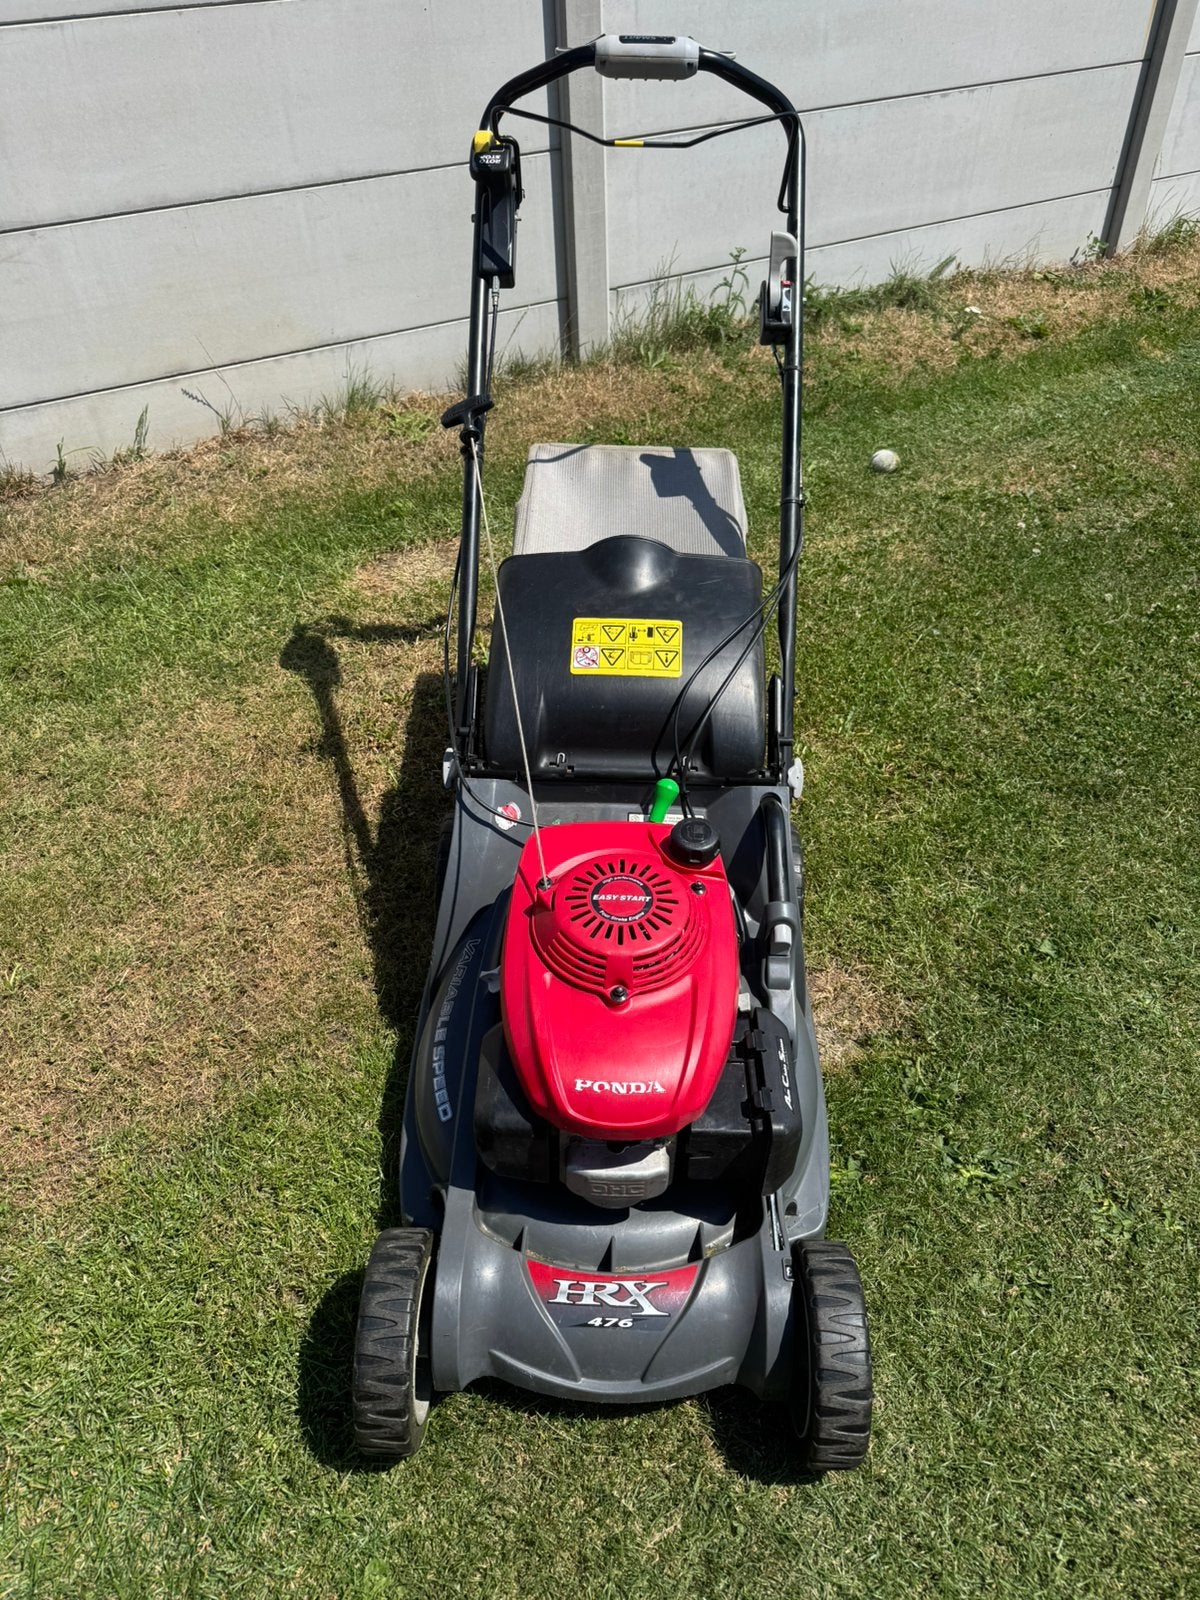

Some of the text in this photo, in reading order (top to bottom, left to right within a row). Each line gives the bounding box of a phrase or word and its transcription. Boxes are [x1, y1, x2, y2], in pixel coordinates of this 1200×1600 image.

[432, 938, 481, 1122] VARIABLE SPEED
[547, 1279, 671, 1316] HRX
[587, 1317, 634, 1328] 476
